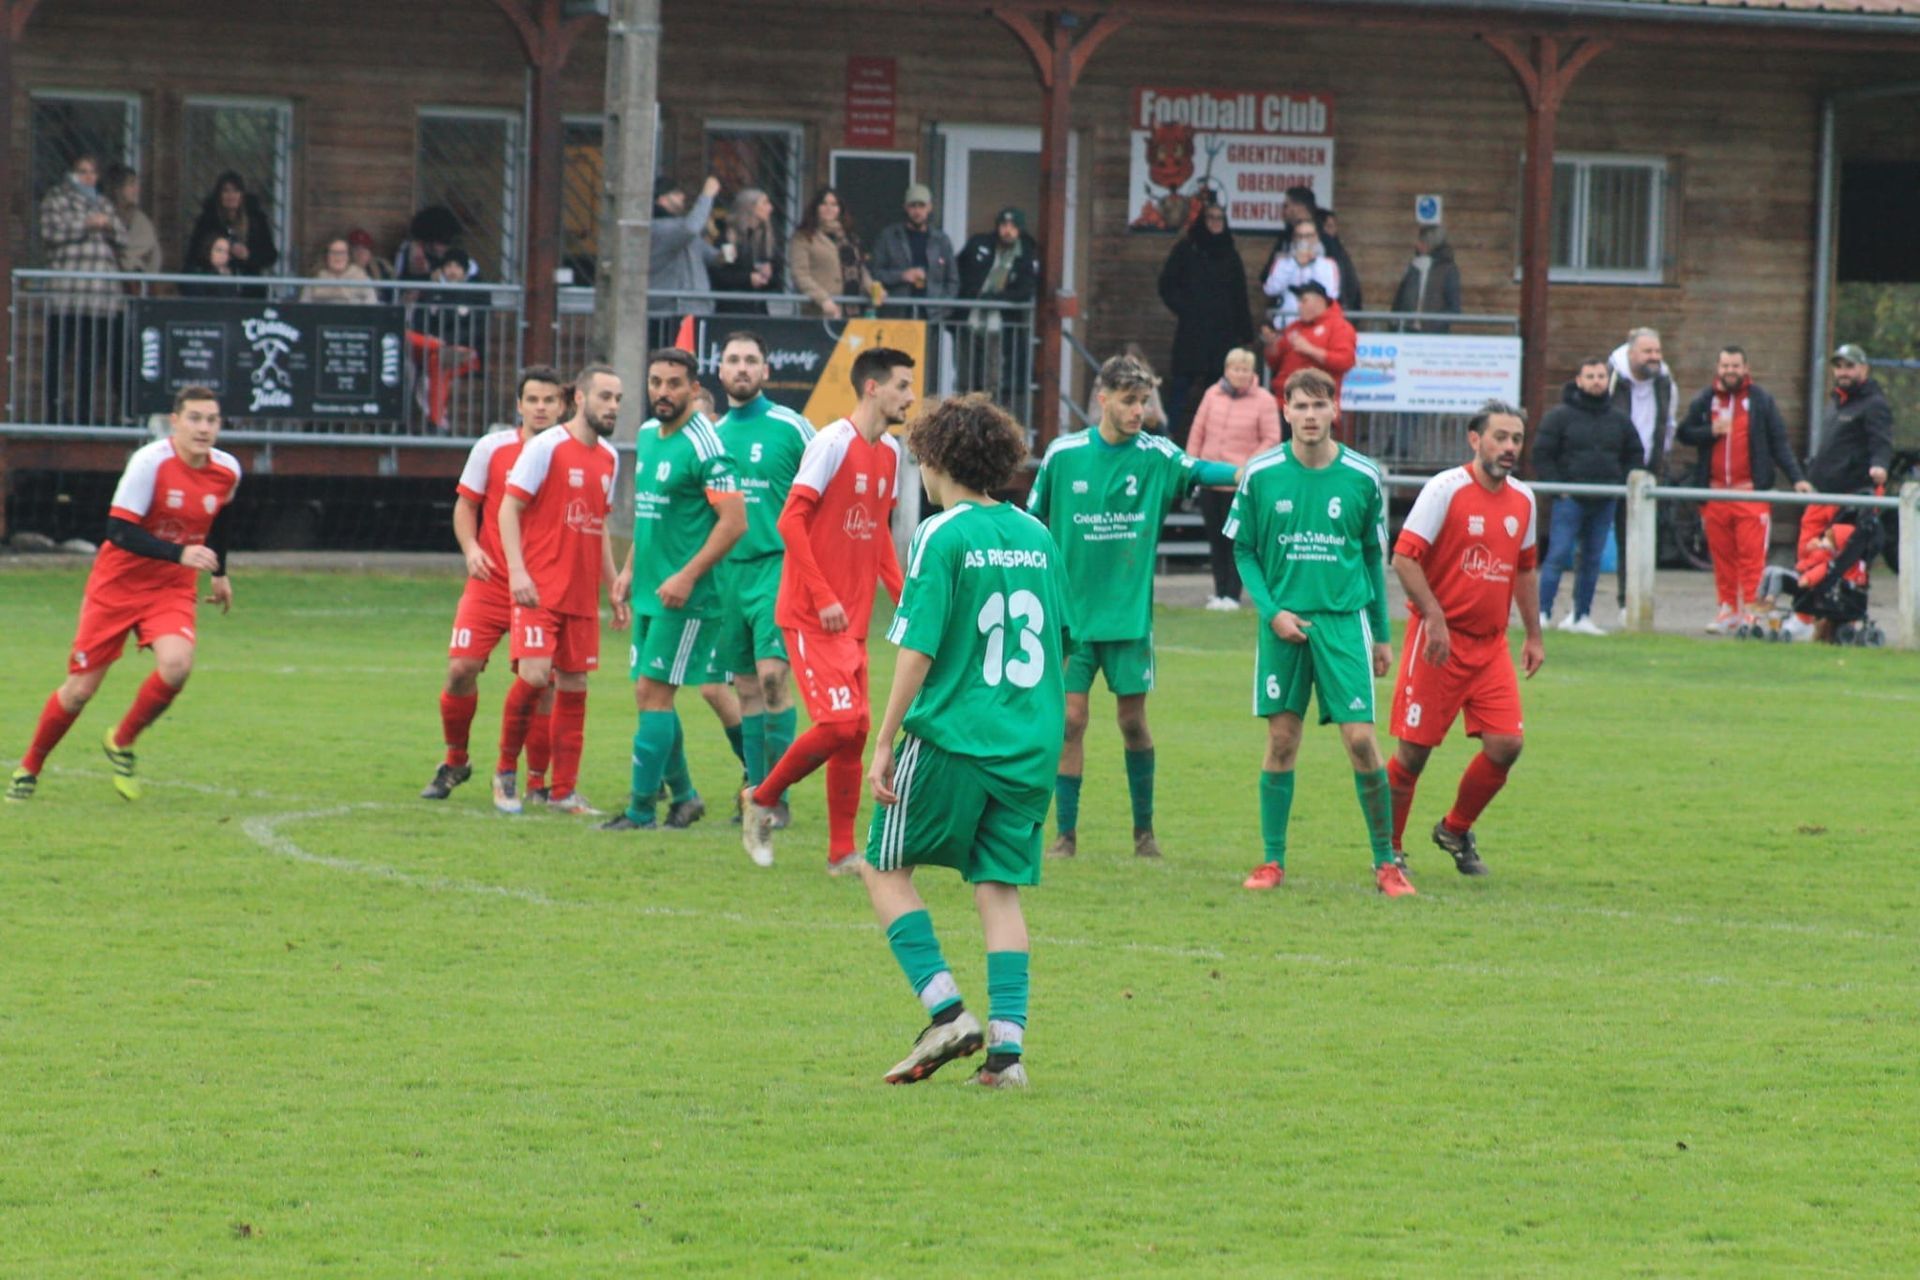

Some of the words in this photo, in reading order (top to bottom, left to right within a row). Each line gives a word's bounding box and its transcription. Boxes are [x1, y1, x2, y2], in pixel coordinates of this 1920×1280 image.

[1140, 90, 1255, 131] Football
[1262, 94, 1327, 133] Club
[1227, 143, 1326, 166] GRENTZINGEN
[1231, 200, 1285, 220] HENFLI
[750, 443, 763, 463] 5
[655, 460, 671, 482] 10
[1125, 474, 1138, 496] 2
[1327, 496, 1342, 519] 6
[965, 549, 985, 569] AS
[450, 627, 471, 648] 10
[524, 625, 545, 648] 11
[977, 589, 1045, 689] 13
[828, 685, 852, 711] 12
[1266, 674, 1281, 700] 6
[1406, 703, 1422, 728] 8
